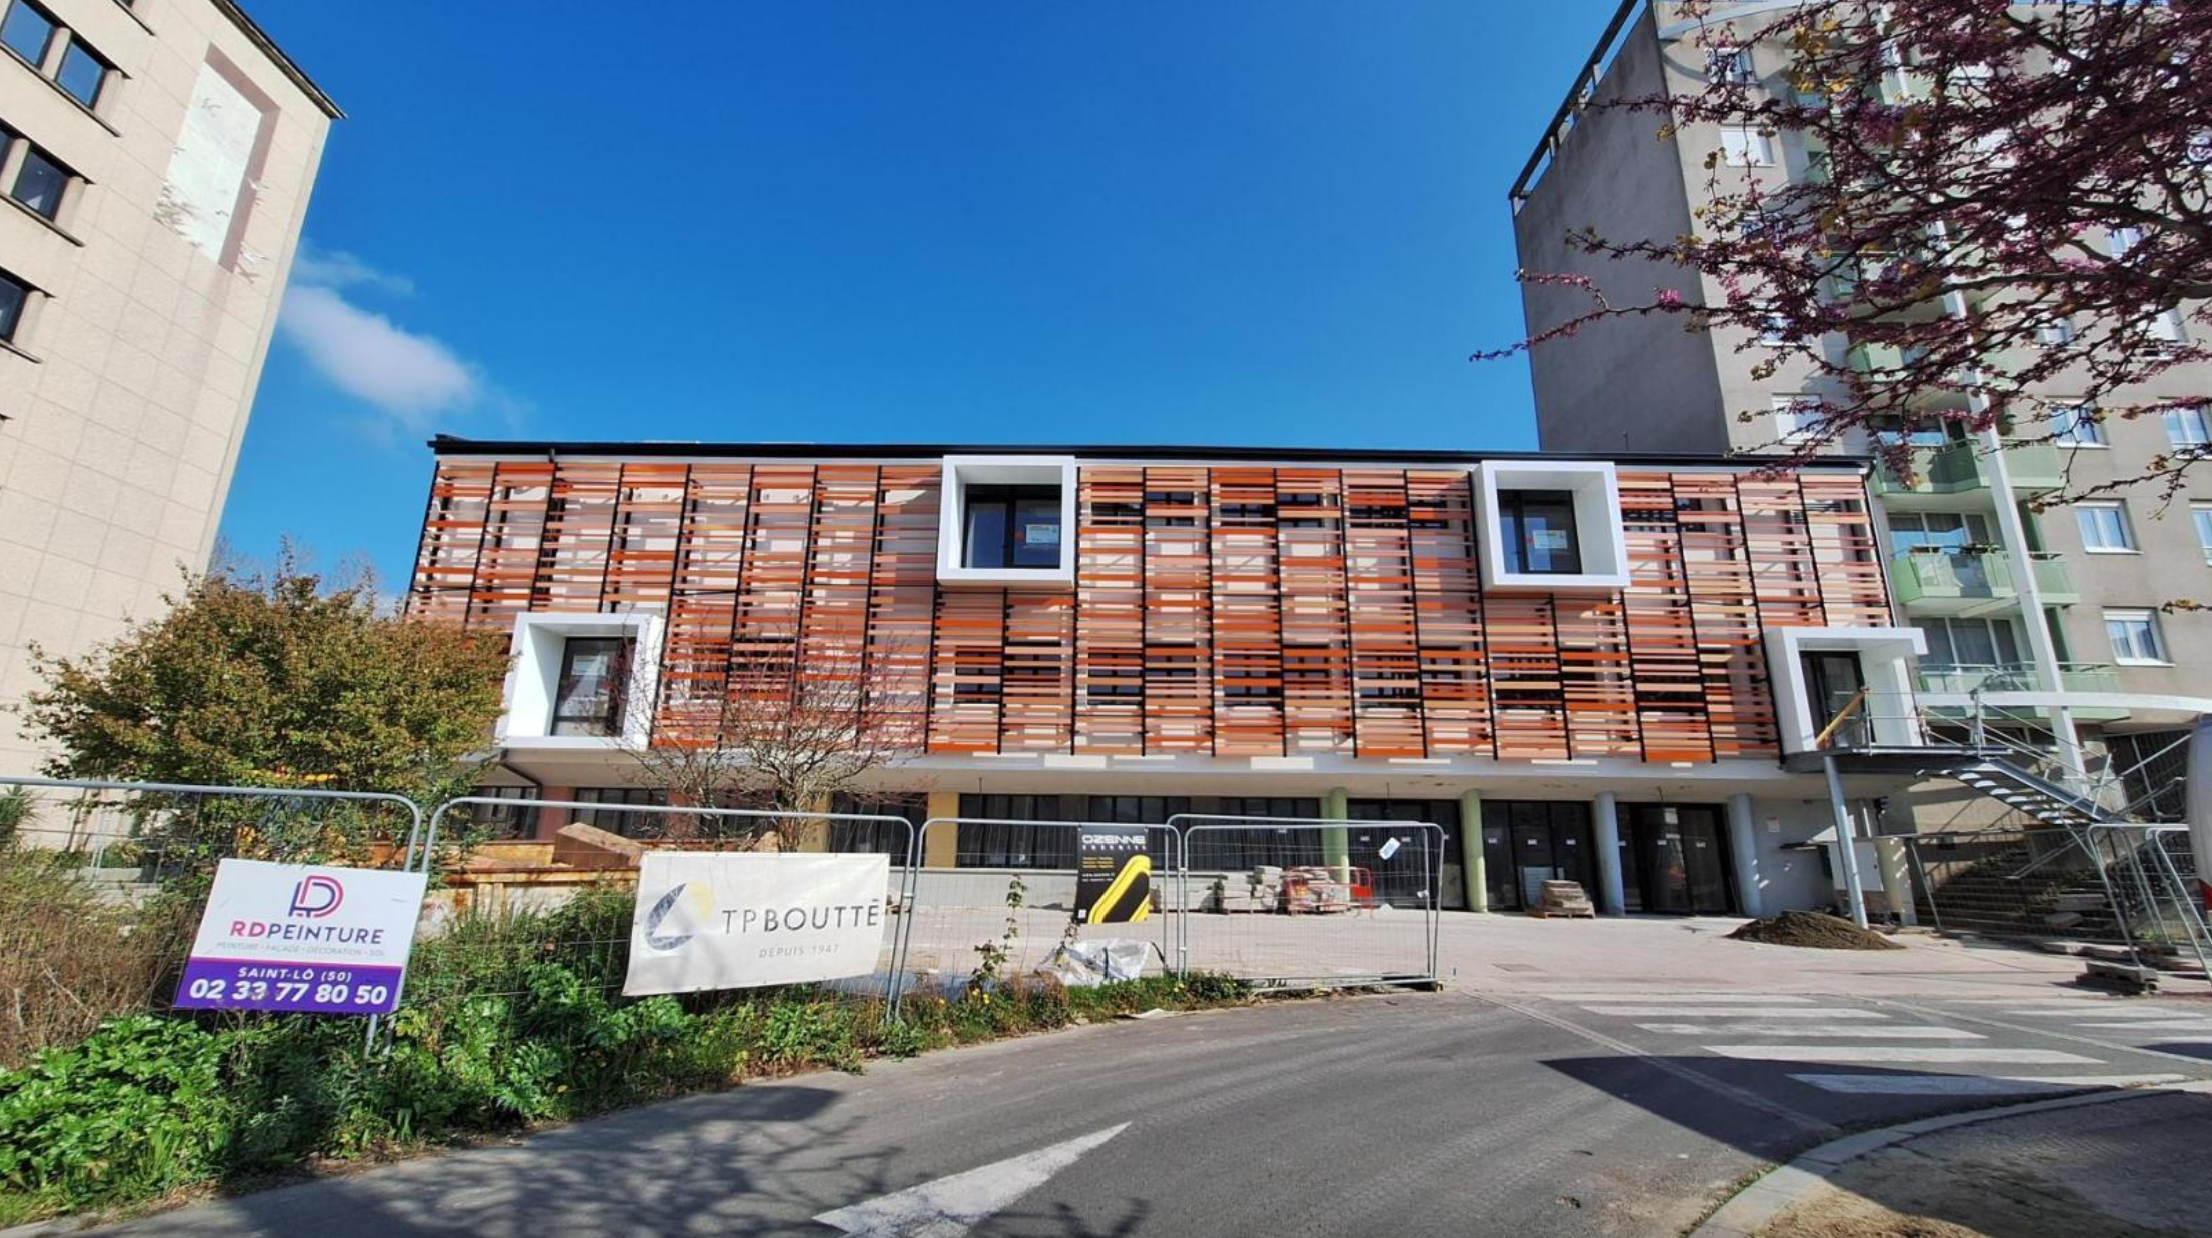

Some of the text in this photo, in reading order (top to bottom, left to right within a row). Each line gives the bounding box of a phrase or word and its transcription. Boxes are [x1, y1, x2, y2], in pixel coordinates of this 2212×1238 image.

[1082, 834, 1146, 844] OZENNE
[758, 943, 840, 958] DEPUIS 1947
[238, 966, 353, 983] SAINT-LÔ (50)
[189, 978, 388, 1005] 02 33 77 80 50
